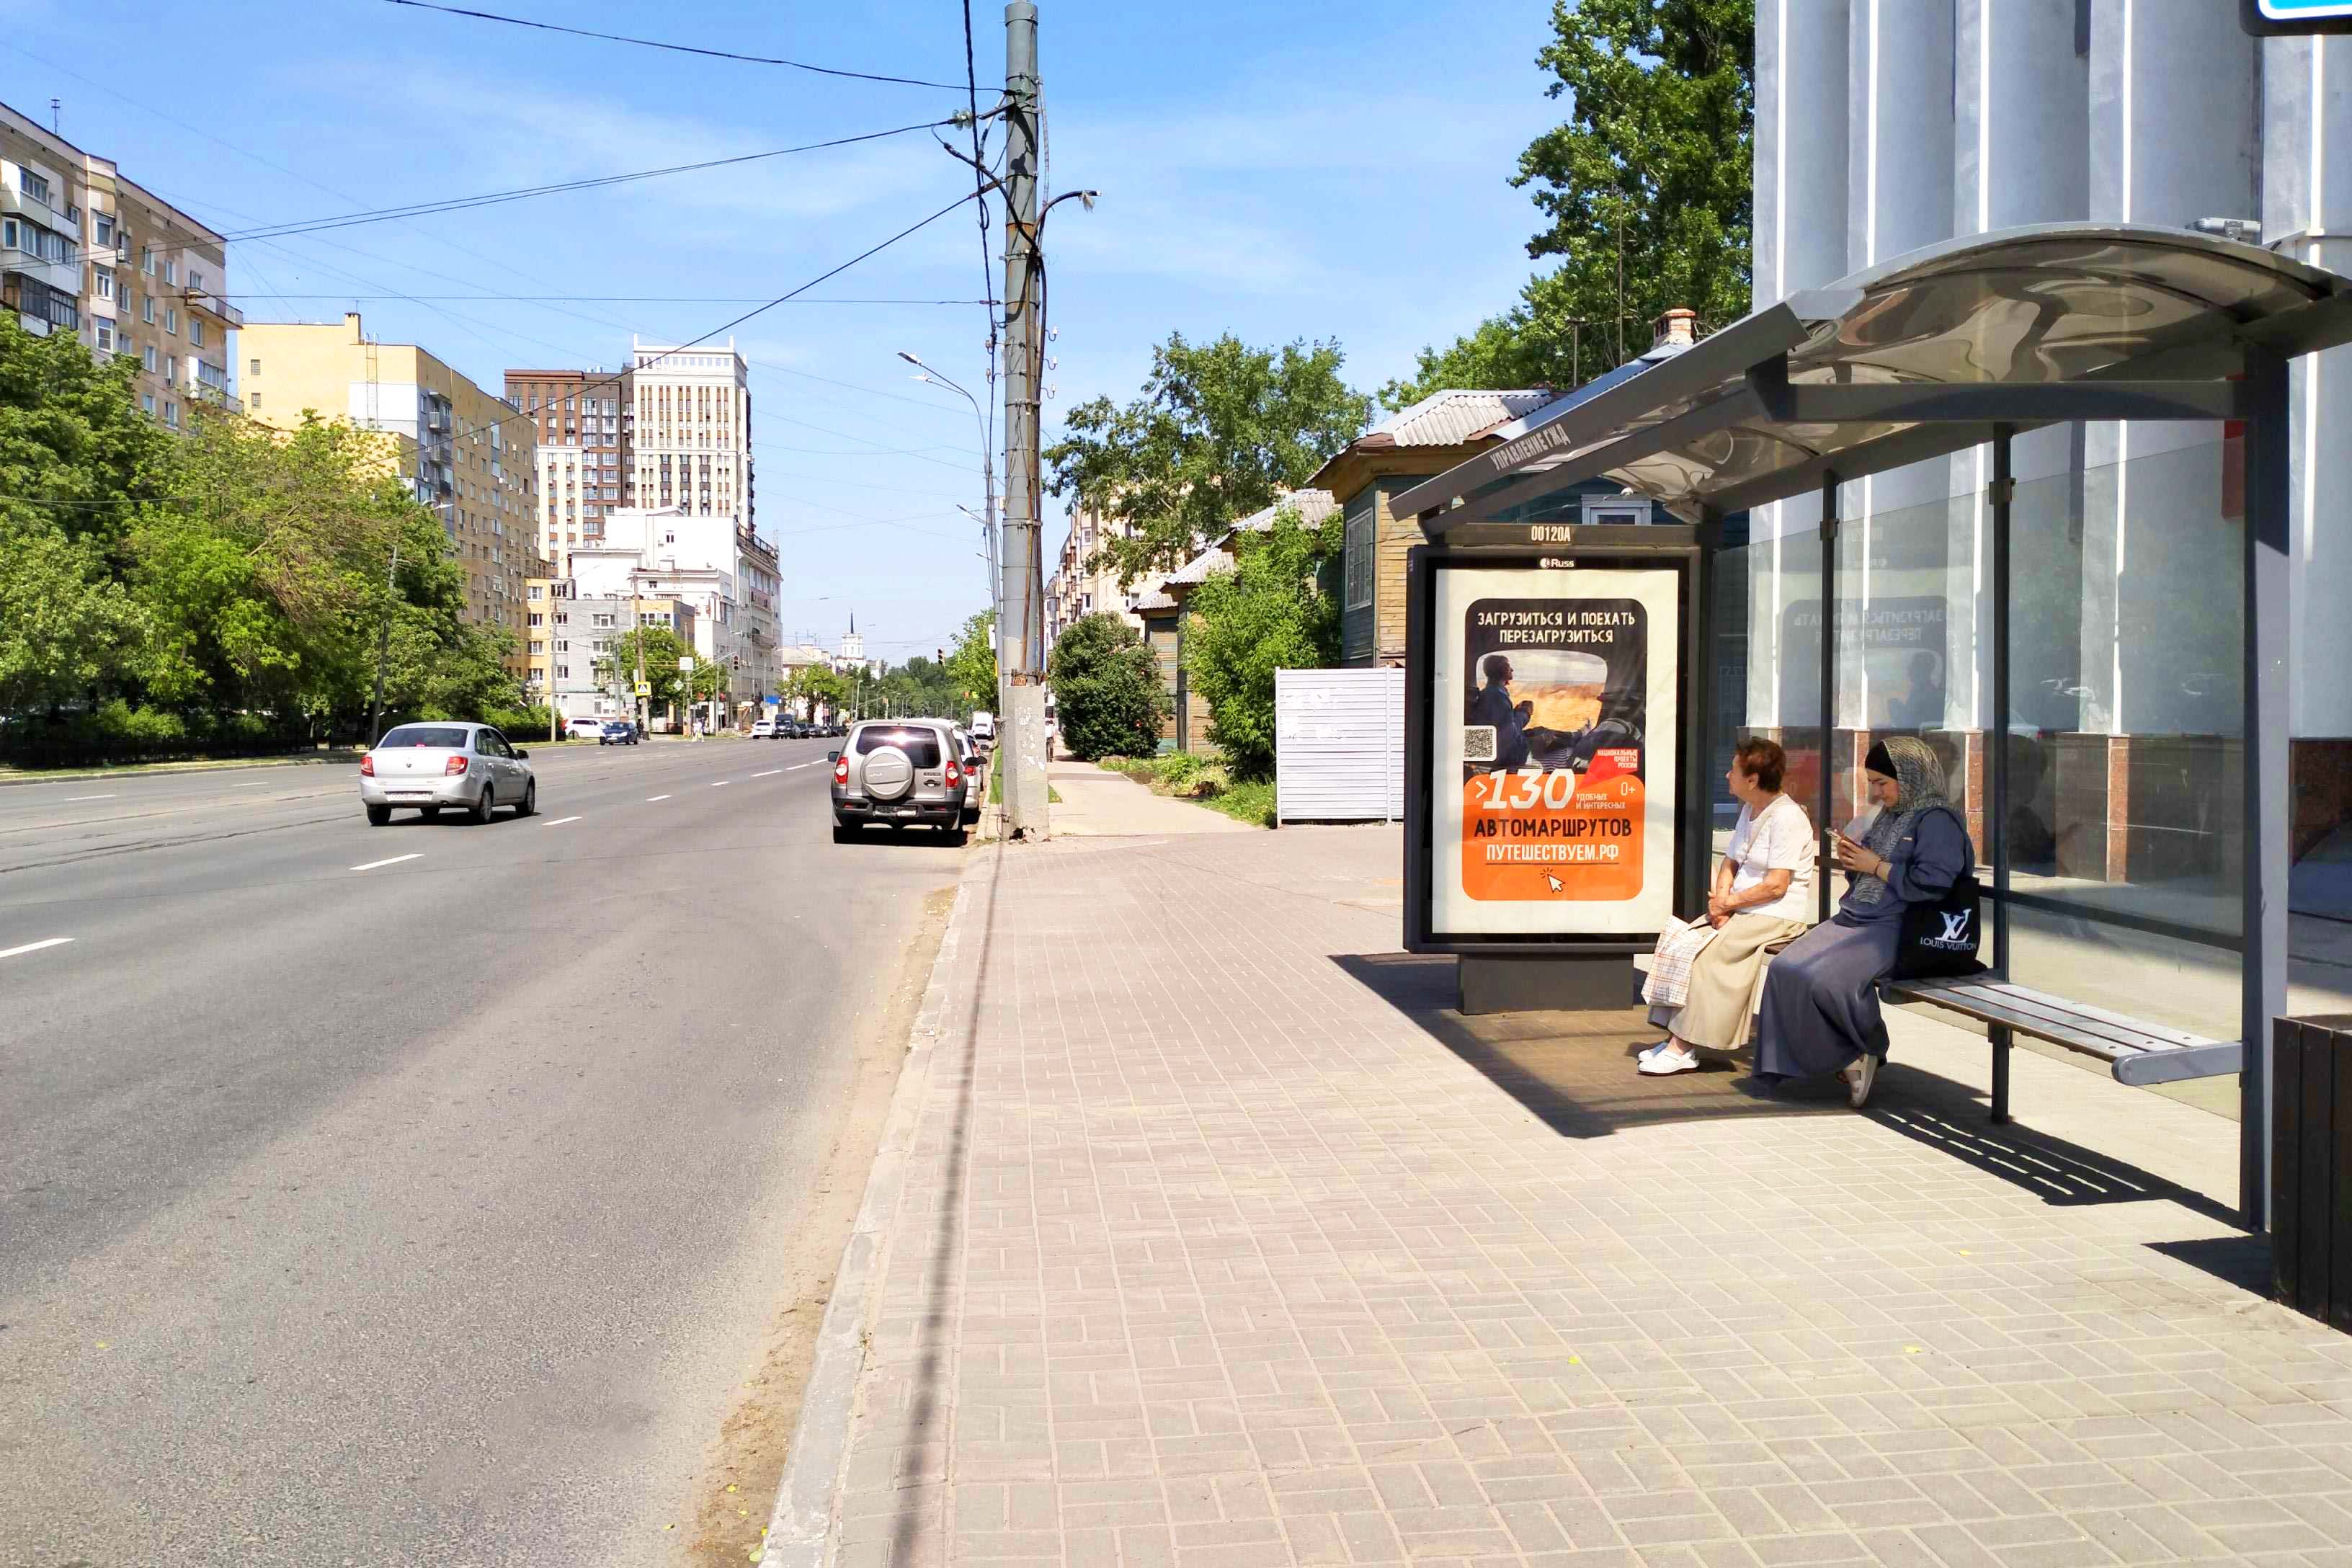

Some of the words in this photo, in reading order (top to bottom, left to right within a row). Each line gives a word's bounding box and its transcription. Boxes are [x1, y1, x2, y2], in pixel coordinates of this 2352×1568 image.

[1489, 432, 1549, 471] УПРАВЛЕНИЕ
[1543, 423, 1571, 448] ГЖД
[1531, 525, 1571, 542] 00120A
[1551, 558, 1574, 568] Russ
[1477, 612, 1563, 625] ЗАГРУЗИТЬСЯ
[1567, 612, 1577, 625] И
[1581, 612, 1636, 625] ПОЕХАТЬ
[1499, 629, 1614, 643] ПЕРЕЗАГРУЗИТЬСЯ
[1621, 782, 1636, 796] 0+
[1474, 819, 1631, 837] АВТОМАРШРУТОВ
[1487, 844, 1619, 860] ПУТЕШЕСТВУЕМ.РФ
[1920, 937, 1944, 948] LOUIS
[1947, 942, 1977, 951] VUITTON
